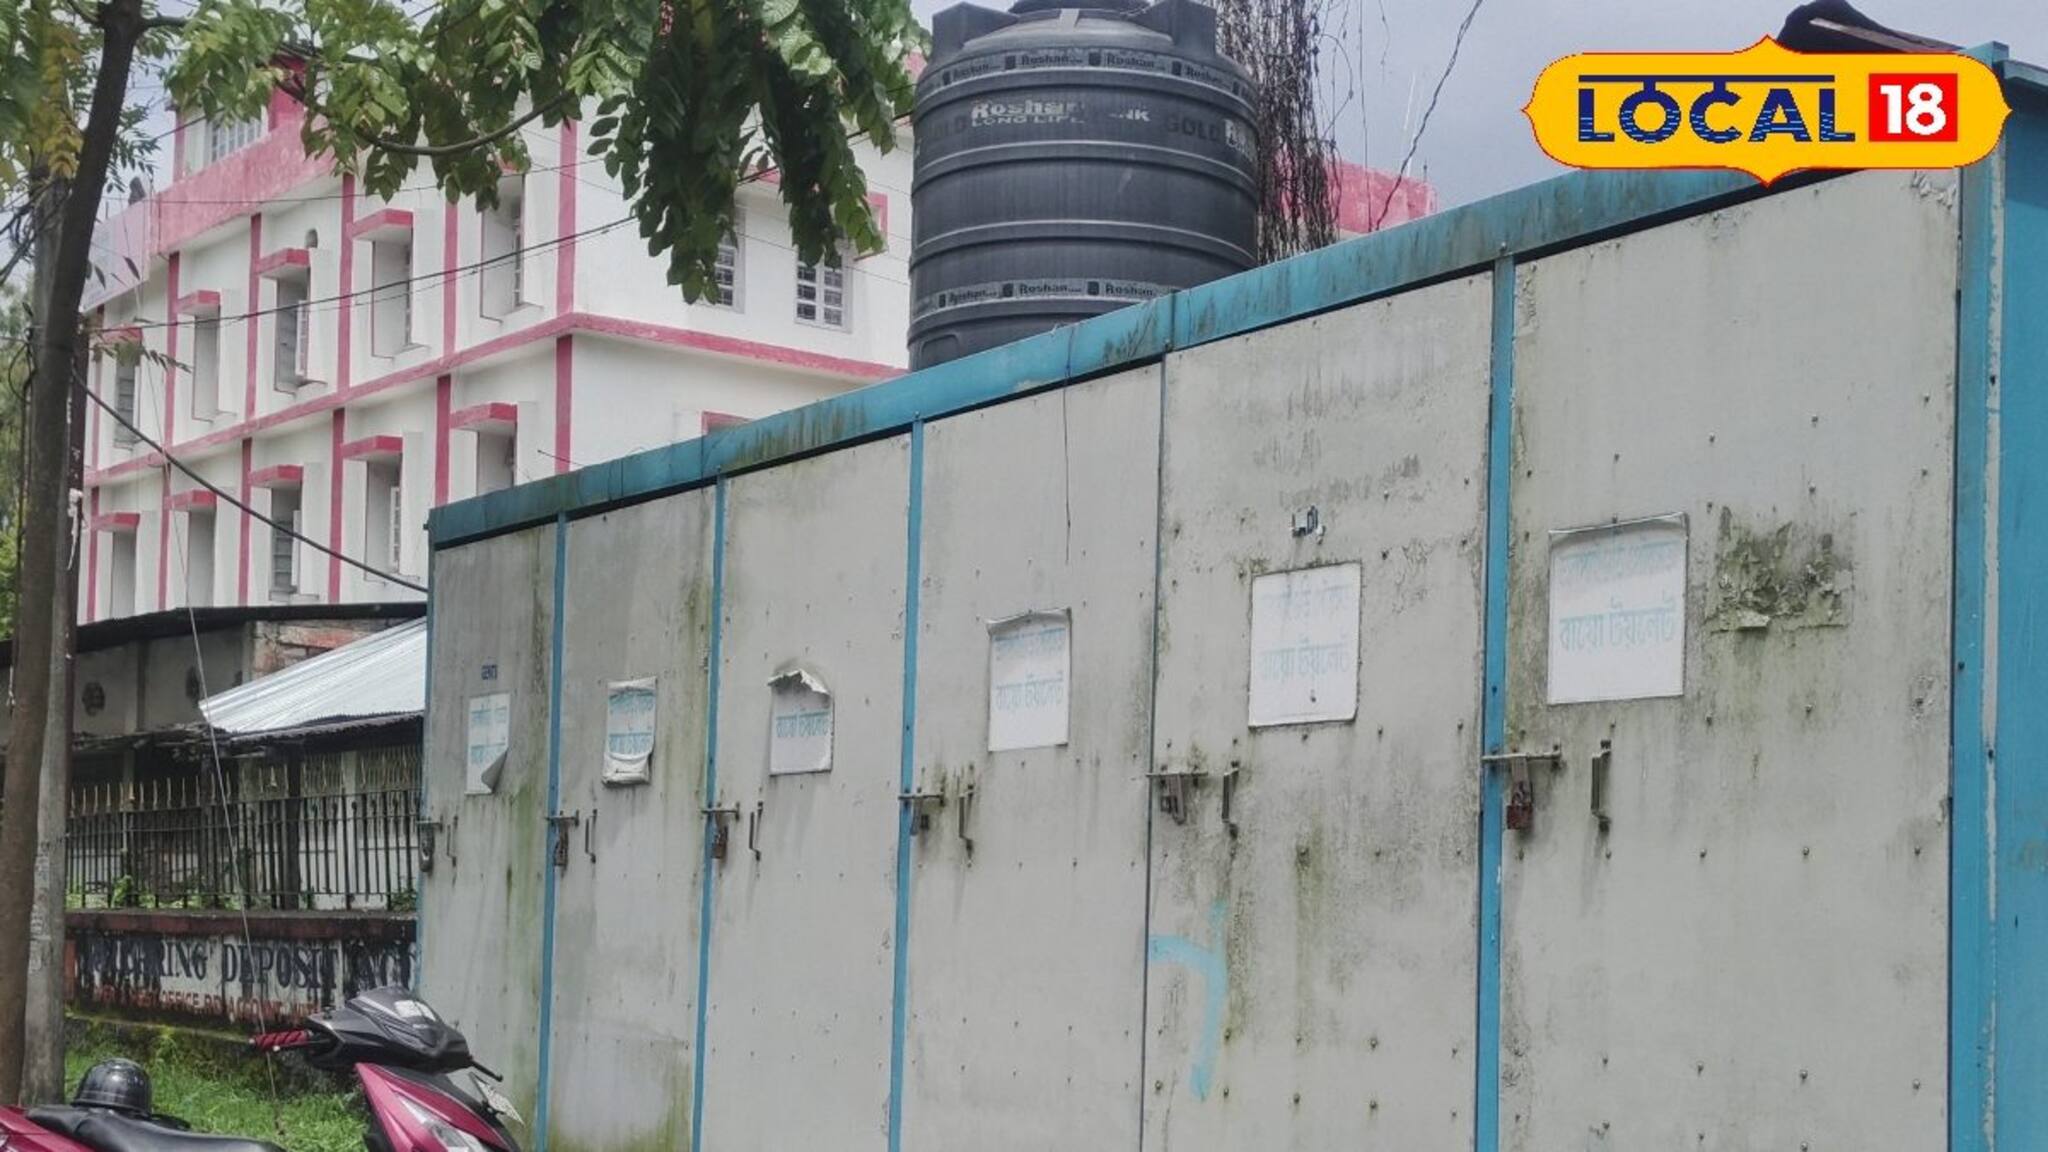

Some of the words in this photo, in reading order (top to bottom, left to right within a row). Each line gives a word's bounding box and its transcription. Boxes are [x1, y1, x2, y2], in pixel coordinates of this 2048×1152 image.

[1021, 54, 1070, 66] Roshan
[1106, 53, 1155, 68] Roshan
[971, 116, 1027, 127] LONG
[1019, 283, 1068, 295] Roshan
[1105, 283, 1154, 297] Roshan
[222, 943, 339, 989] DEPOSIT
